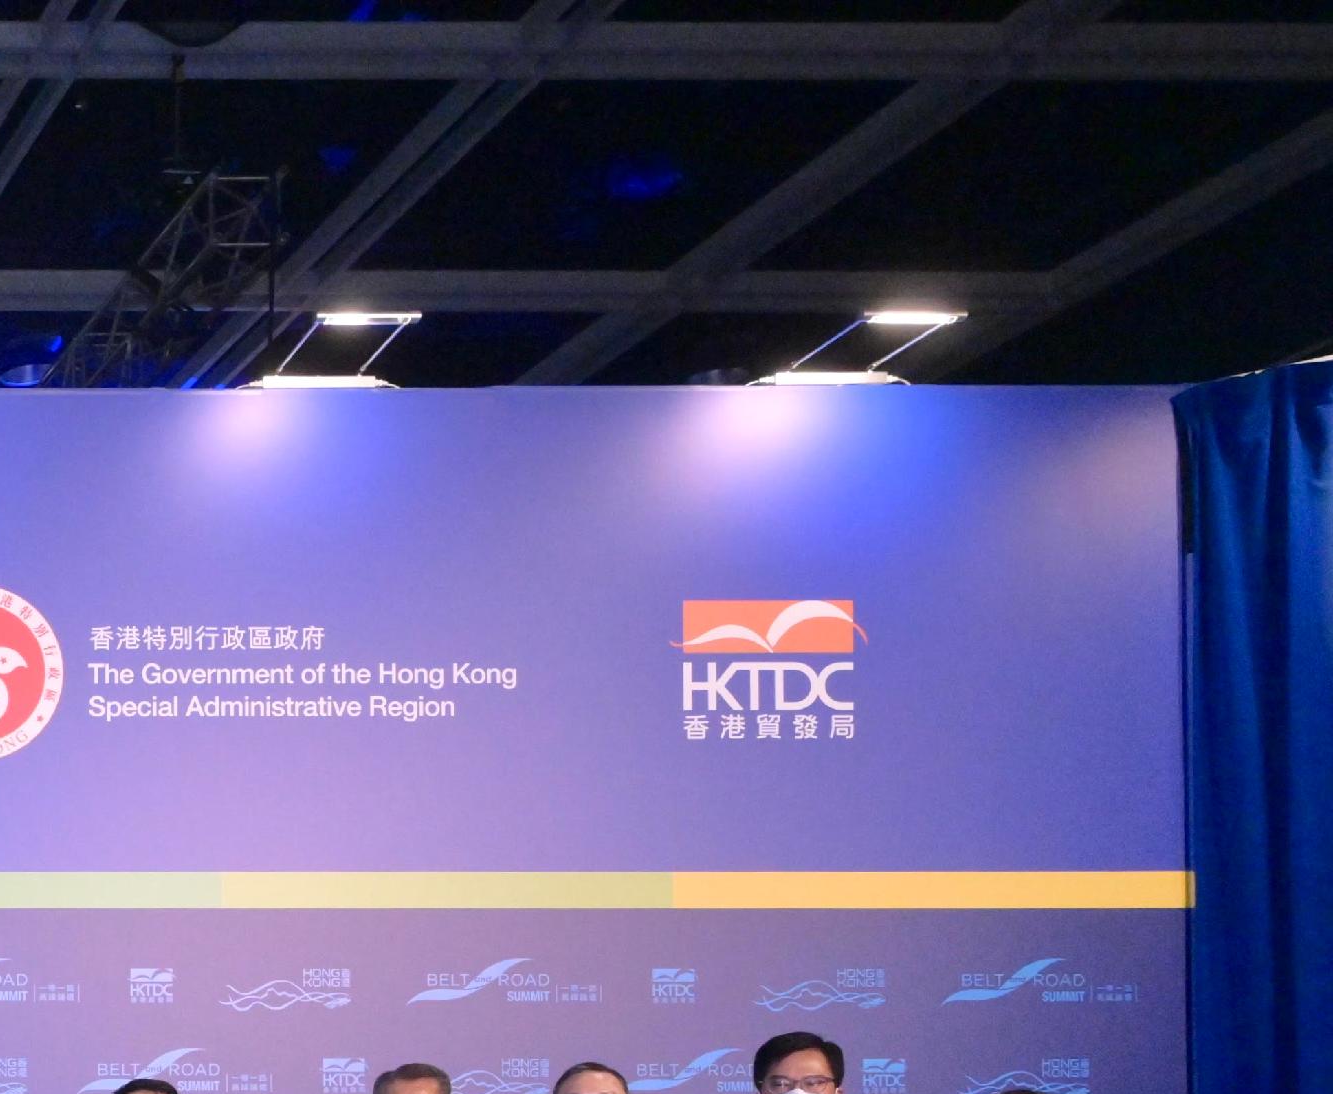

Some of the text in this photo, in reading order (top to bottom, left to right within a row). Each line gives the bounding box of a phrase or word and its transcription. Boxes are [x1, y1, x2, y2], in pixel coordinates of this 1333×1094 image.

[89, 625, 326, 651] 香港特別行政區政府
[88, 662, 518, 690] The Government of the Hong Kong
[682, 661, 854, 711] HKTDC
[87, 695, 455, 723] Special Administrative Region
[683, 713, 854, 740] 香港貿發局
[427, 974, 549, 986] BELT ROAD
[961, 974, 1085, 986] BELT ROAD
[507, 991, 549, 1001] SUMMIT
[1042, 991, 1085, 1001] SUMMIT
[97, 1064, 220, 1076] BELT ROAD
[637, 1064, 679, 1076] BELT
[177, 1081, 220, 1091] SUMMIT
[717, 1082, 754, 1092] SUMMI
